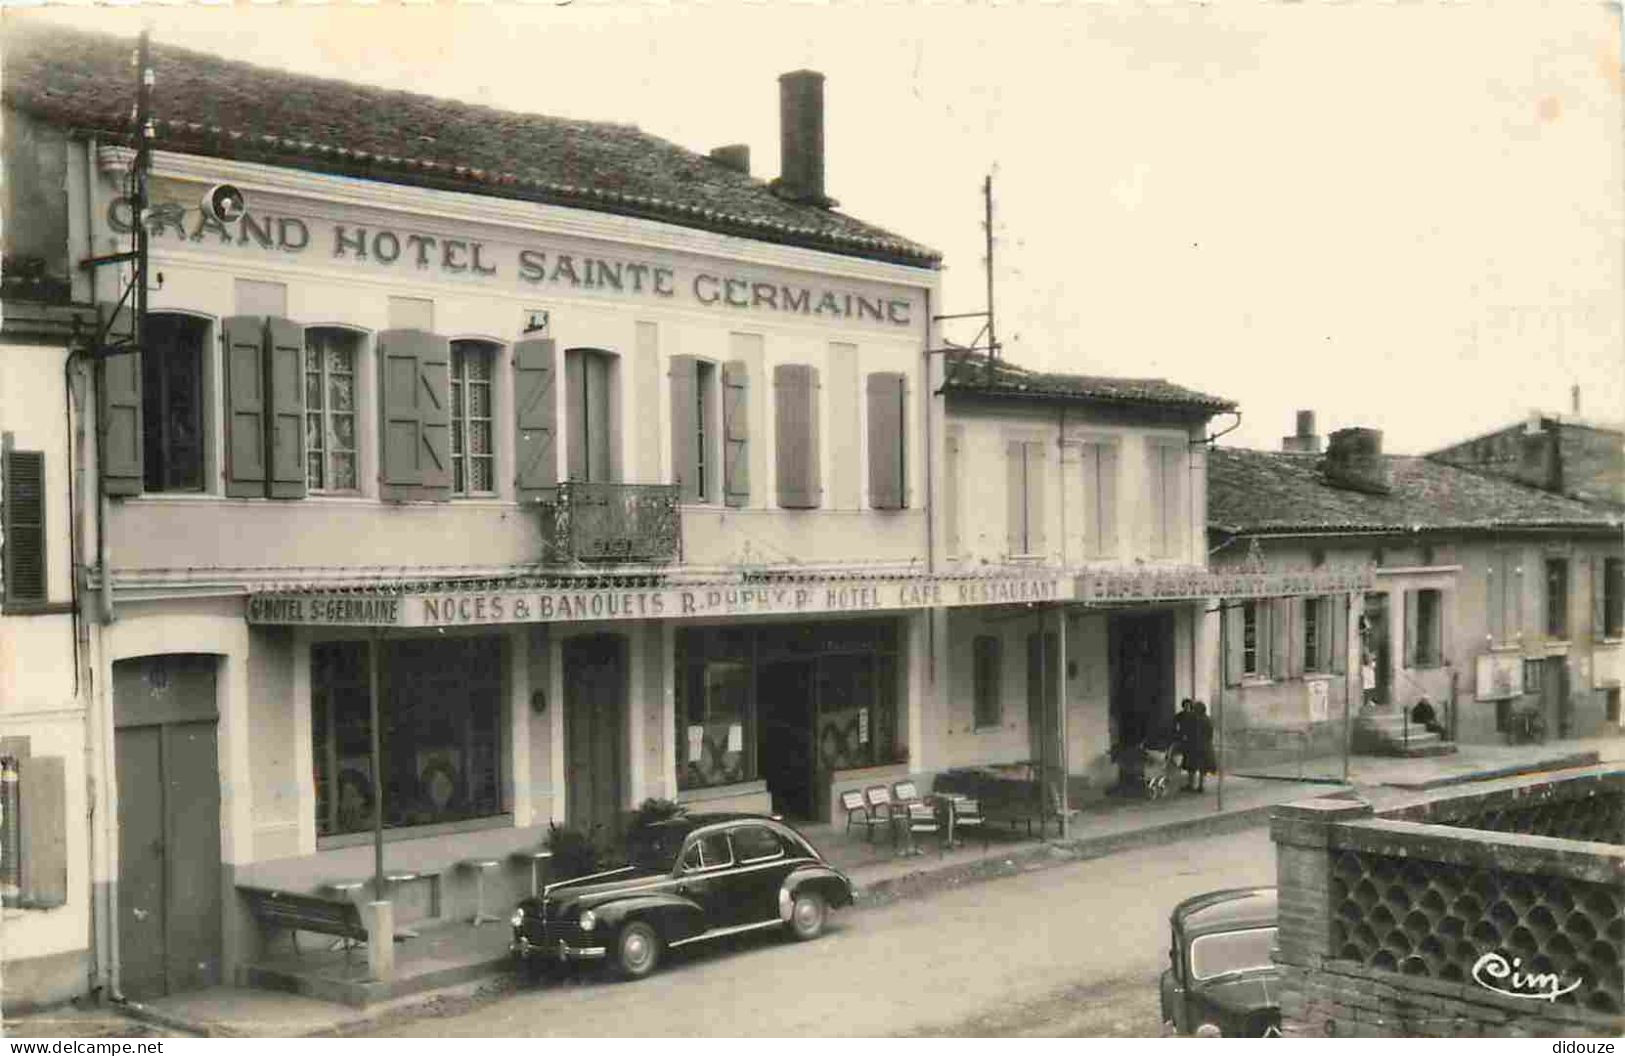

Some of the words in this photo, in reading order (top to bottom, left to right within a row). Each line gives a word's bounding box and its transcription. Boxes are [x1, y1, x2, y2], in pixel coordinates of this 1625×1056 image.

[107, 197, 310, 252] GRAND
[333, 225, 497, 275] HOTEL
[518, 250, 675, 297] SAINTE
[693, 273, 912, 326] GERMAINE
[424, 596, 502, 624] NOCES
[513, 598, 530, 617] &
[540, 593, 665, 618] BANQUETS
[827, 587, 881, 608] HOTEL
[959, 580, 1058, 602] RESTAURANT
